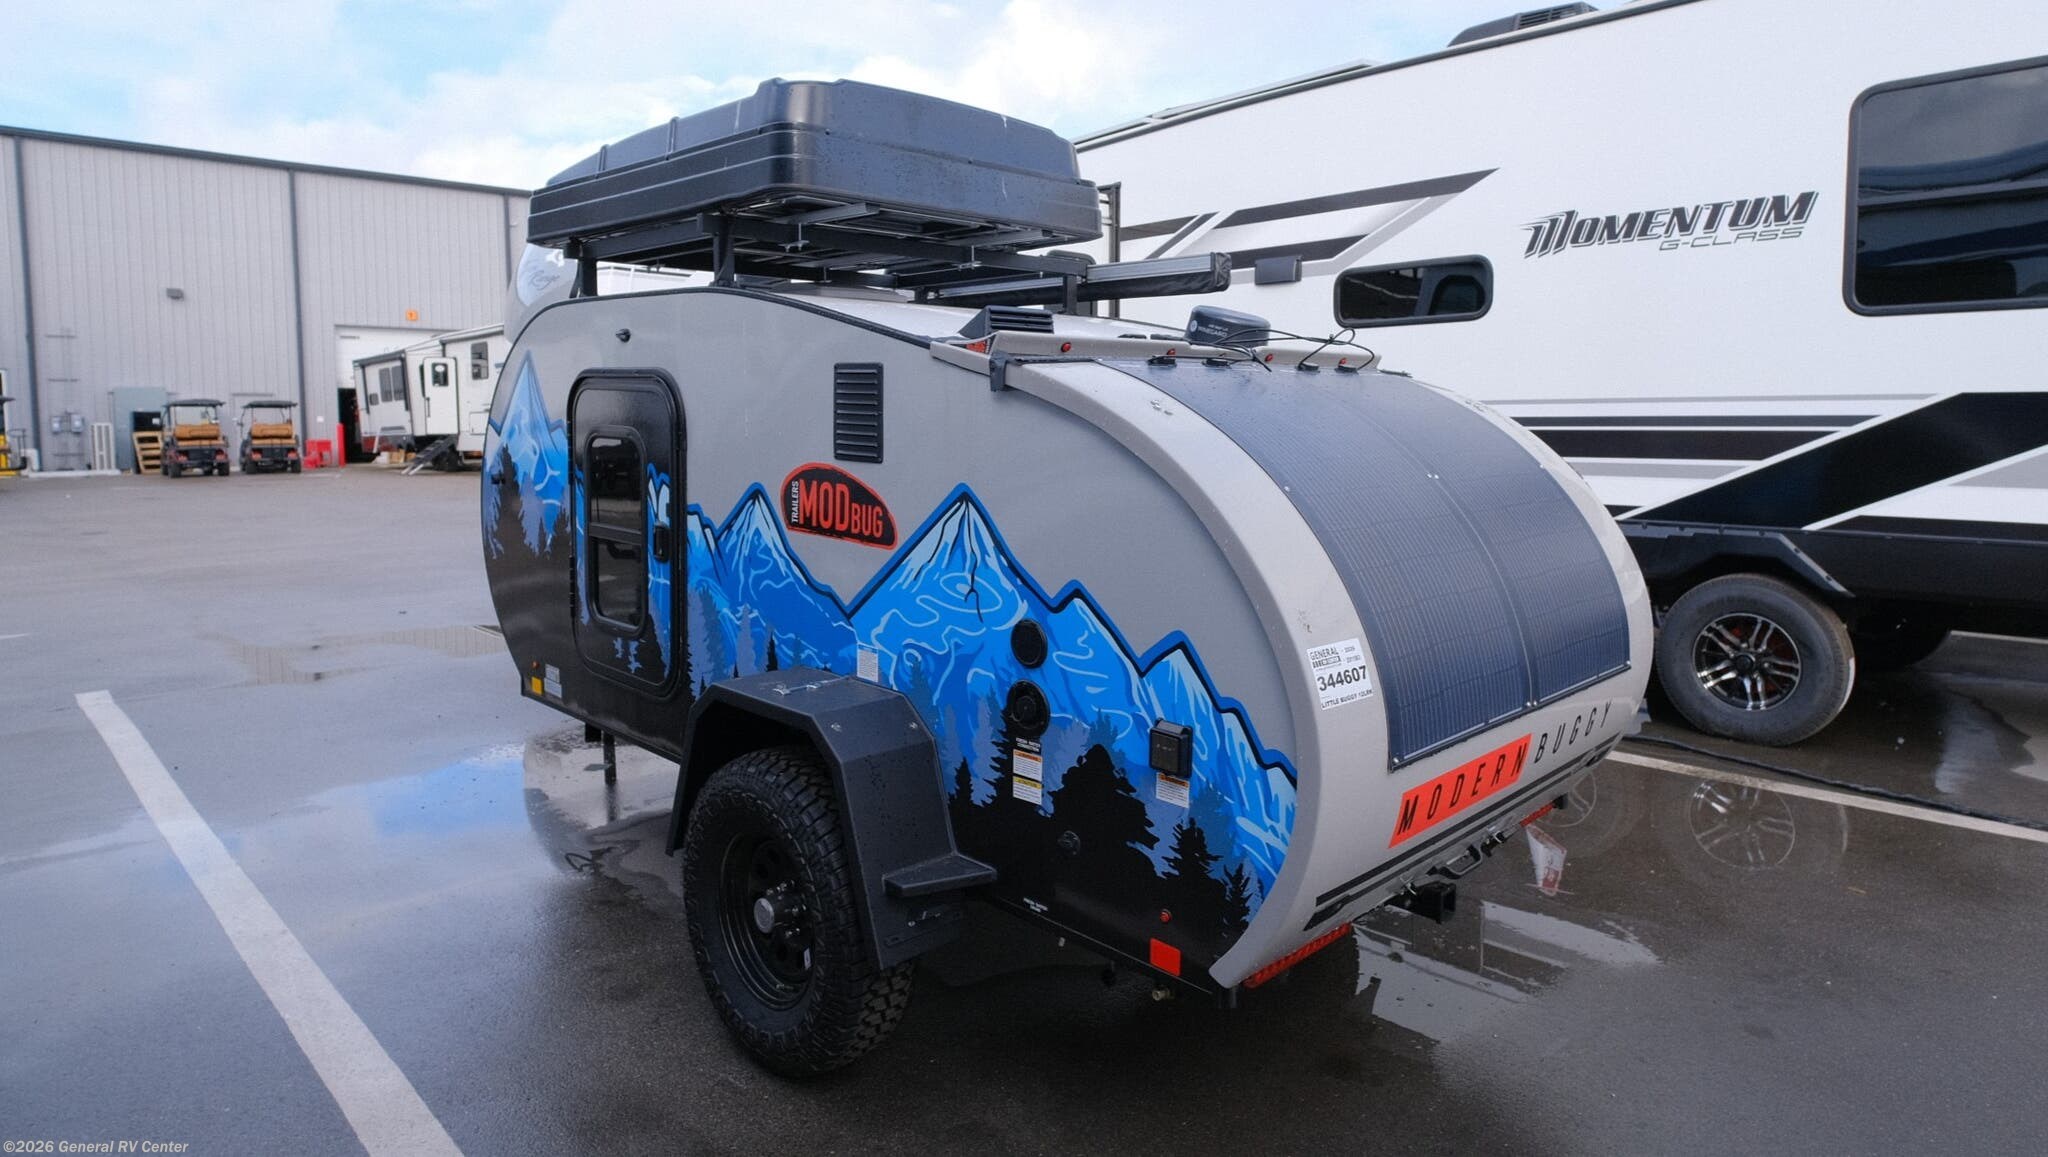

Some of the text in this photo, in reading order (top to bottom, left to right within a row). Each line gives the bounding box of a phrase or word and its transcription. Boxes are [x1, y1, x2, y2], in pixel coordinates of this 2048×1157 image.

[1519, 190, 1819, 259] MOMENTUM
[1658, 226, 1805, 251] G-CLASS
[790, 480, 800, 524] TRAILERS
[1310, 647, 1339, 661] GENERAL
[1317, 665, 1367, 691] 344607
[1321, 697, 1340, 709] LITTLE
[1397, 701, 1612, 836] MODERN BUGGY
